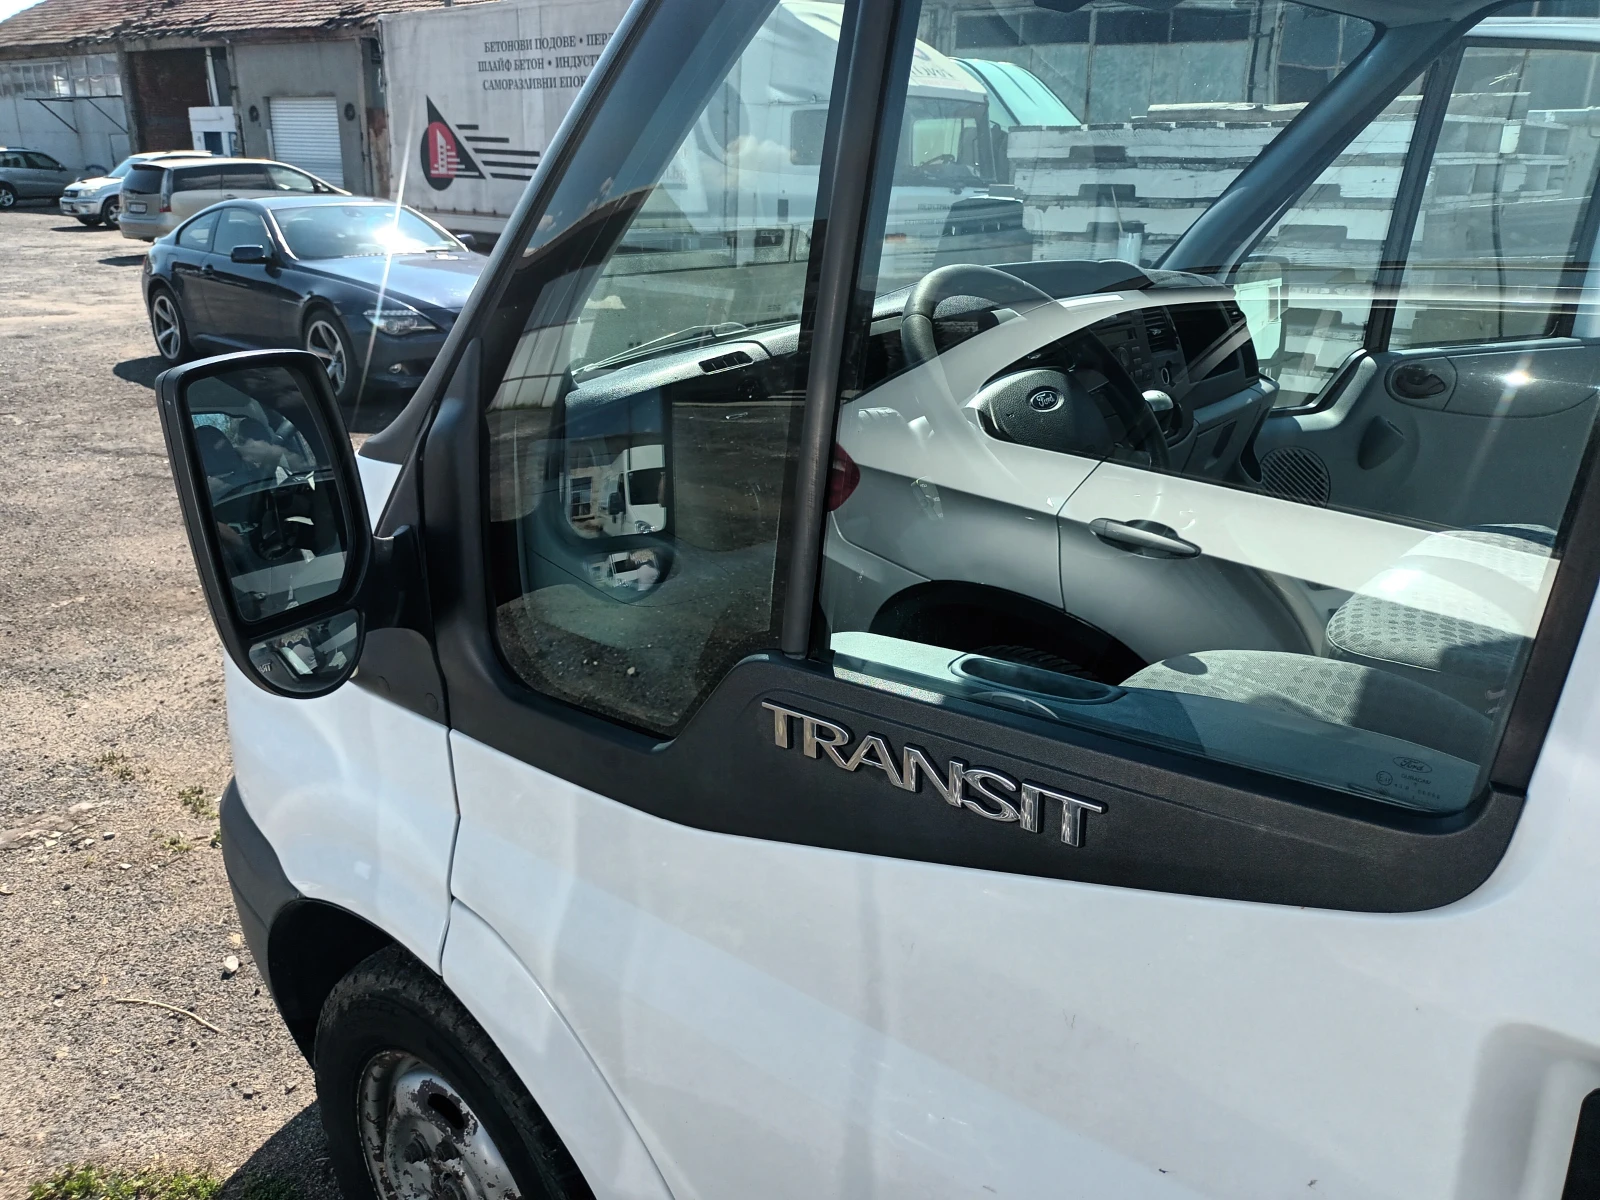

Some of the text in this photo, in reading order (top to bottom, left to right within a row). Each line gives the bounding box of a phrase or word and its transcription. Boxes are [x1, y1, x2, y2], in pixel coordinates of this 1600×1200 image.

[484, 39, 533, 53] БЕТОНОВИ
[534, 36, 576, 51] ПОДОВЕ
[477, 58, 512, 72] ШЛАЙФ
[514, 57, 544, 71] БЕТОН
[483, 77, 557, 91] САМОРАЗЛИВНИ
[761, 698, 1108, 847] TRANSIT
